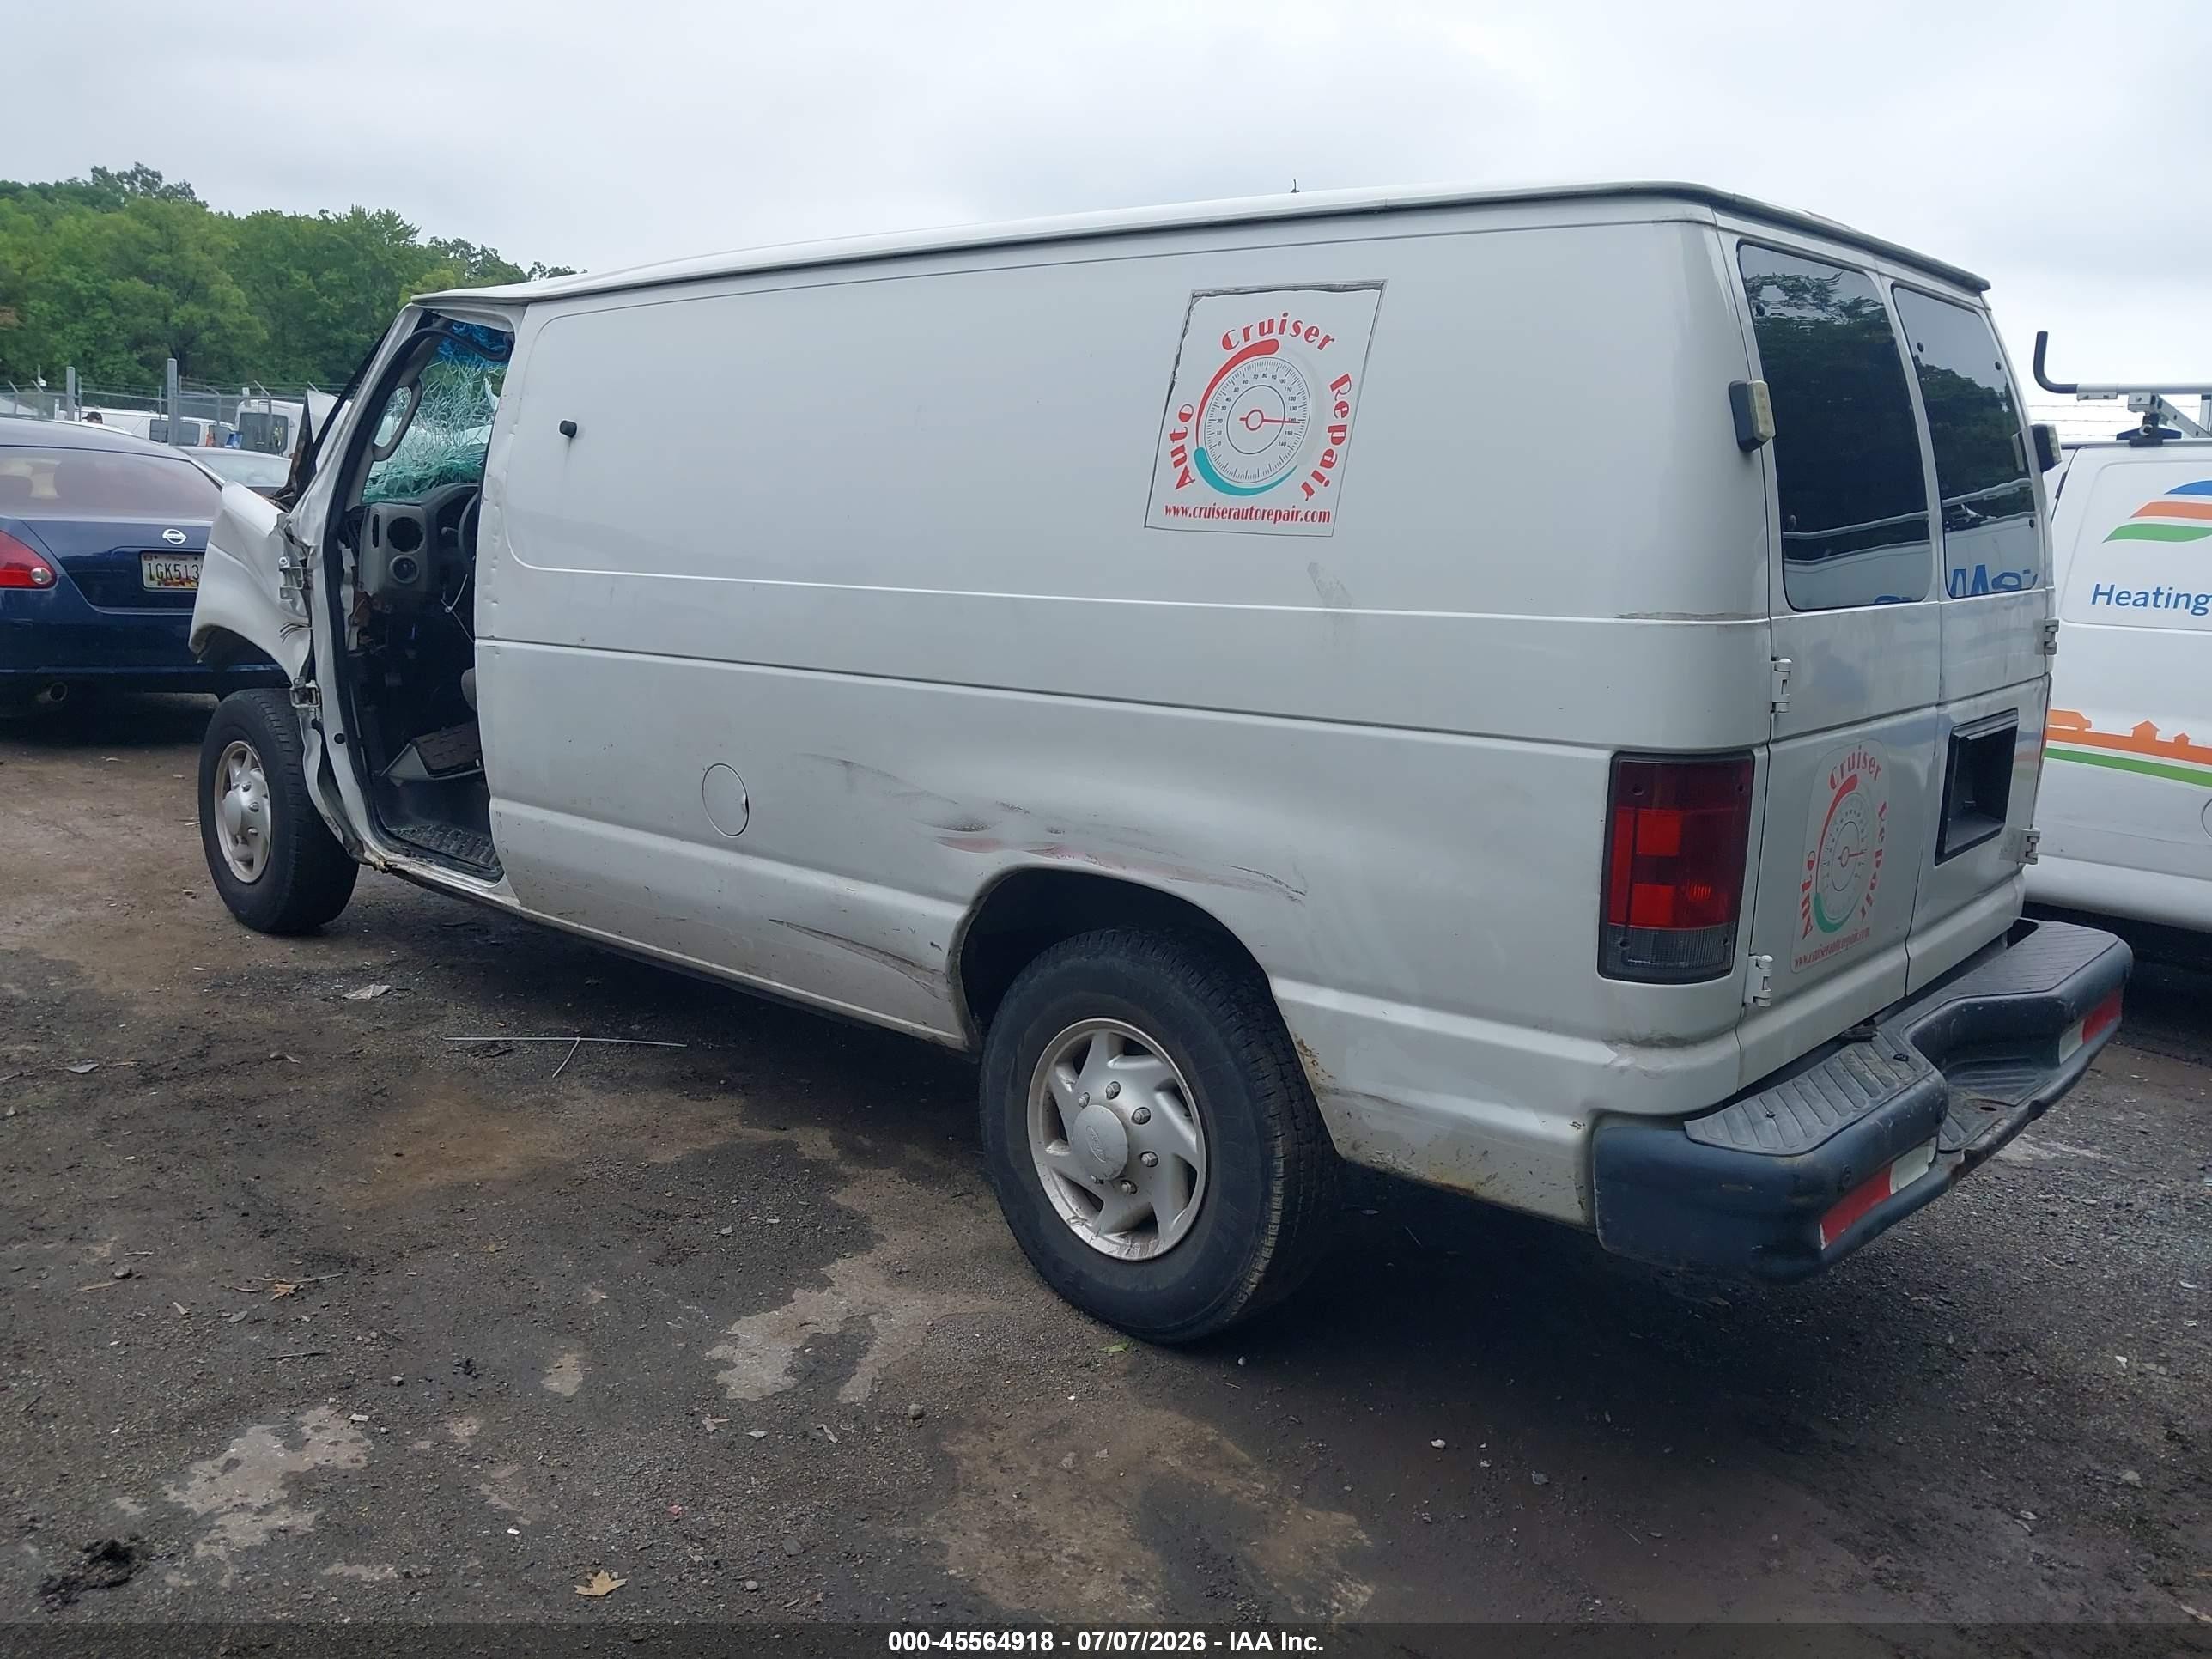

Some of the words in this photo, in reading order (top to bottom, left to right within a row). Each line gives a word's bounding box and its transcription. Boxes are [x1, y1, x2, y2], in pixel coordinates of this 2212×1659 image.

[1221, 312, 1335, 352] Cruiser
[1169, 404, 1195, 490] Auto
[1301, 373, 1352, 502] Repair
[1164, 502, 1331, 525] www.cruiserautorepair.com
[149, 562, 203, 581] 1GK513
[2091, 583, 2212, 617] Heating
[1829, 745, 1882, 790] Cruiser
